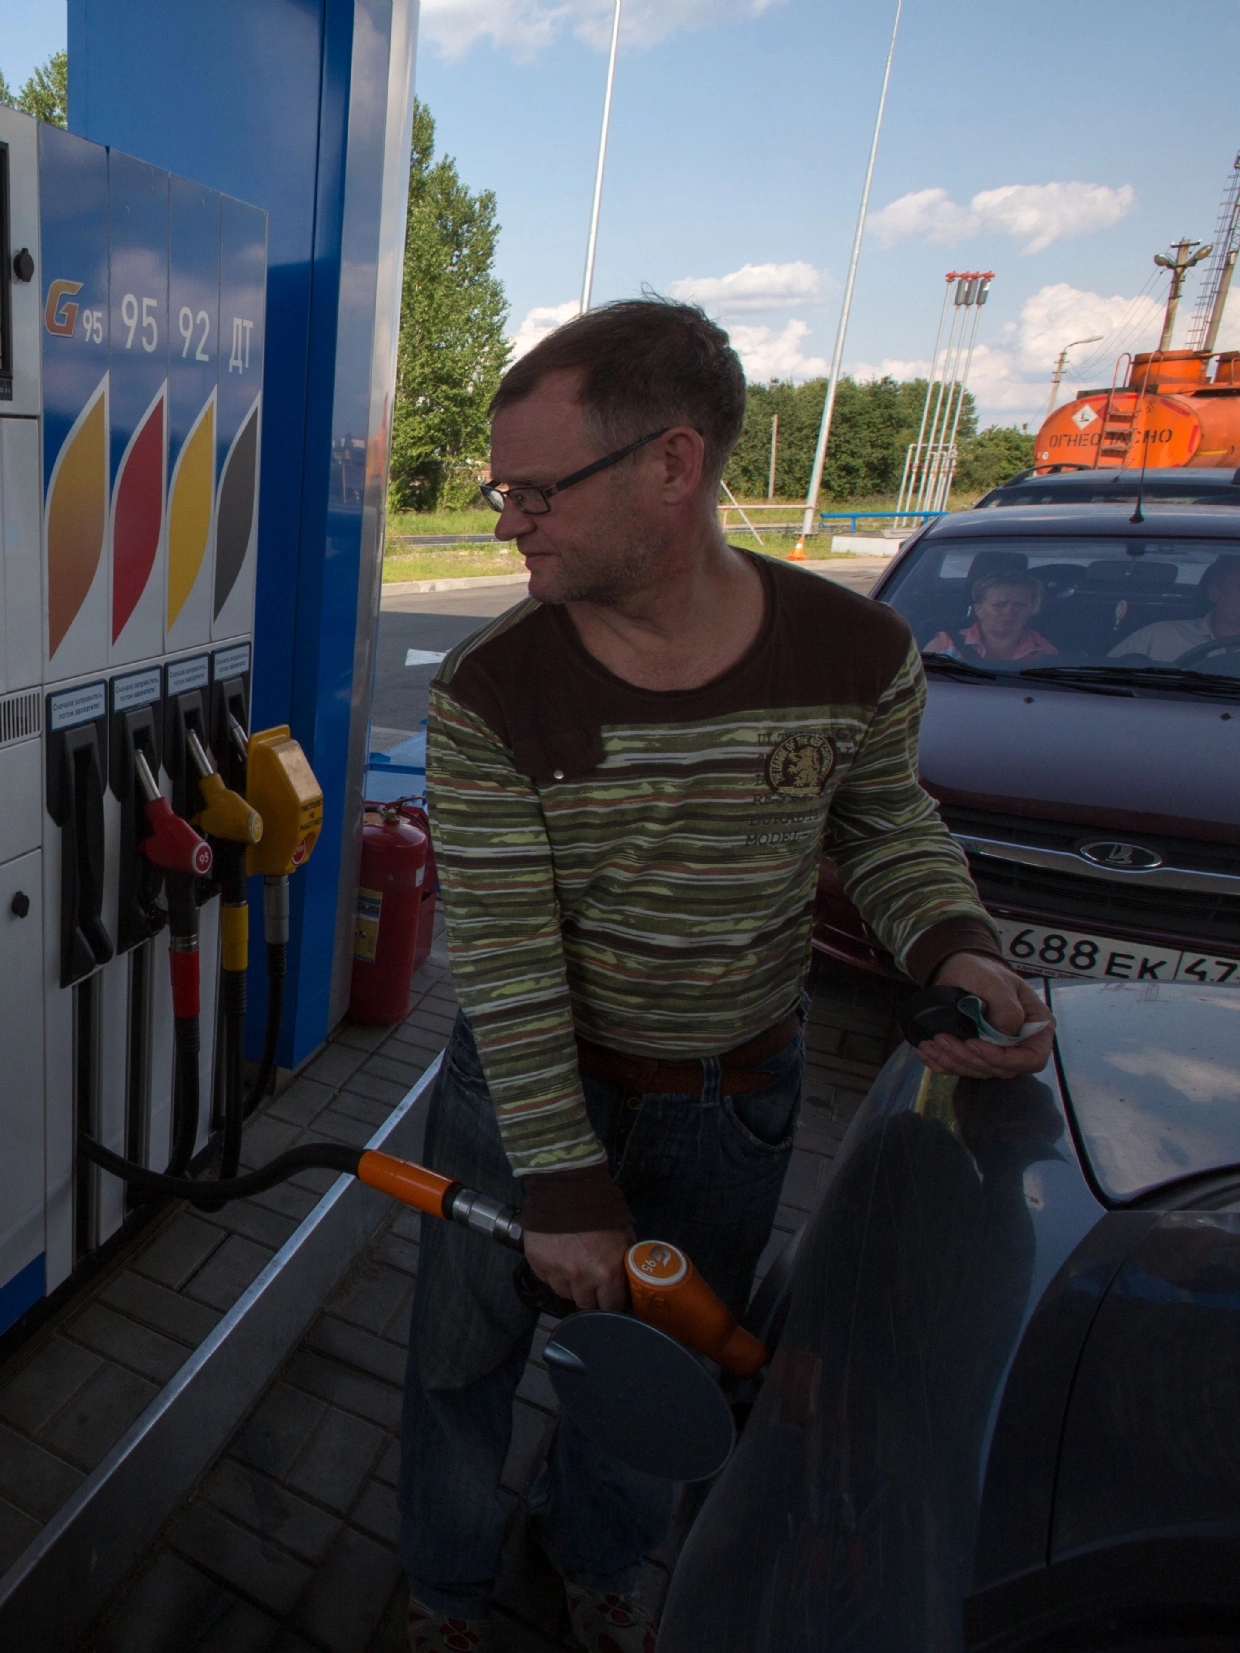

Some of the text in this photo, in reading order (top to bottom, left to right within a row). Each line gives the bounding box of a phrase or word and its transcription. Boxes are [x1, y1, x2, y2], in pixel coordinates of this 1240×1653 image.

[44, 278, 84, 338] G
[83, 309, 103, 344] 95
[121, 293, 158, 353] 95
[178, 306, 210, 362] 92
[228, 317, 254, 374] ДТ
[53, 700, 74, 711] Сначала
[59, 710, 74, 720] потом
[785, 739, 797, 751] OF
[744, 831, 800, 847] MODEL
[199, 852, 209, 865] 95
[1009, 929, 1238, 982] 688ЕК 47
[1016, 964, 1043, 973] УДАЧИ
[641, 1259, 657, 1273] 95
